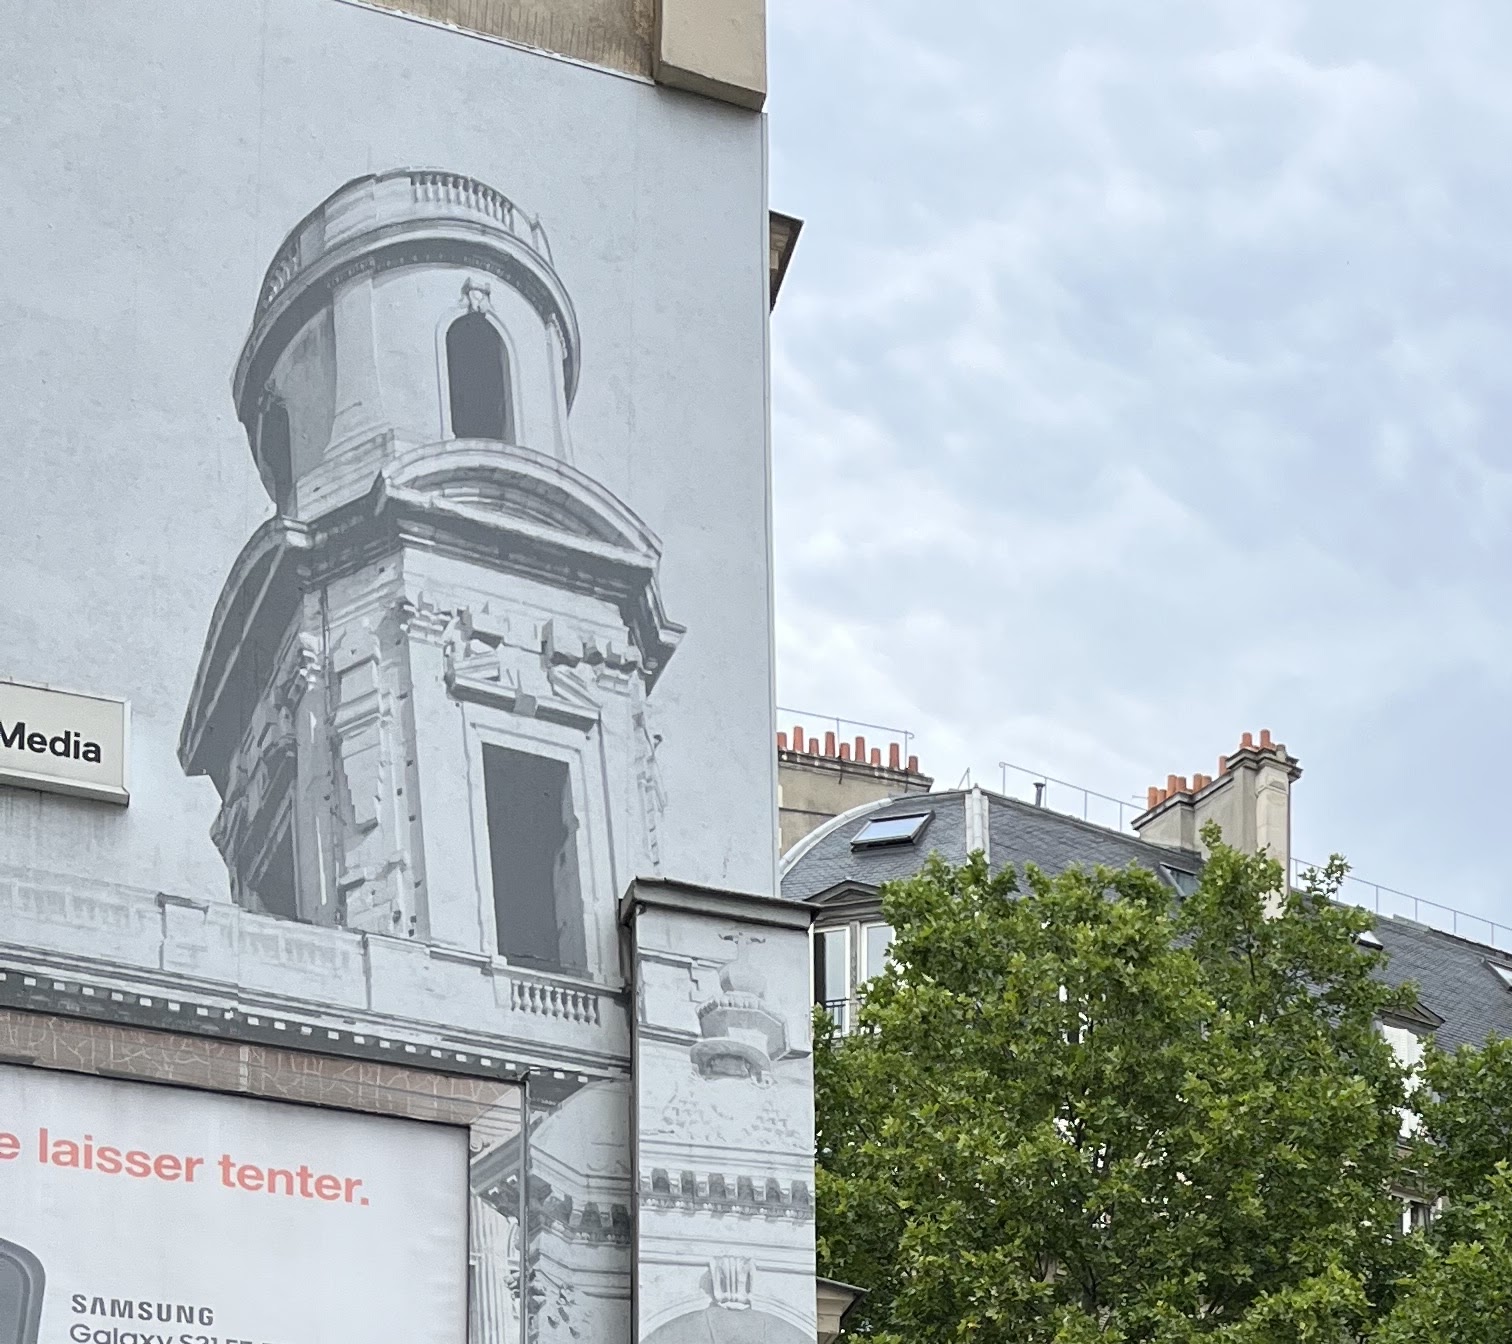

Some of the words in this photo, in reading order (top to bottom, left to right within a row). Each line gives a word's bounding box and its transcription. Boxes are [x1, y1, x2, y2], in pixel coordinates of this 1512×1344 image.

[0, 722, 101, 763] Media
[39, 1127, 204, 1182] laisser
[218, 1154, 369, 1206] tenter.
[71, 1293, 214, 1326] SAMSUNG
